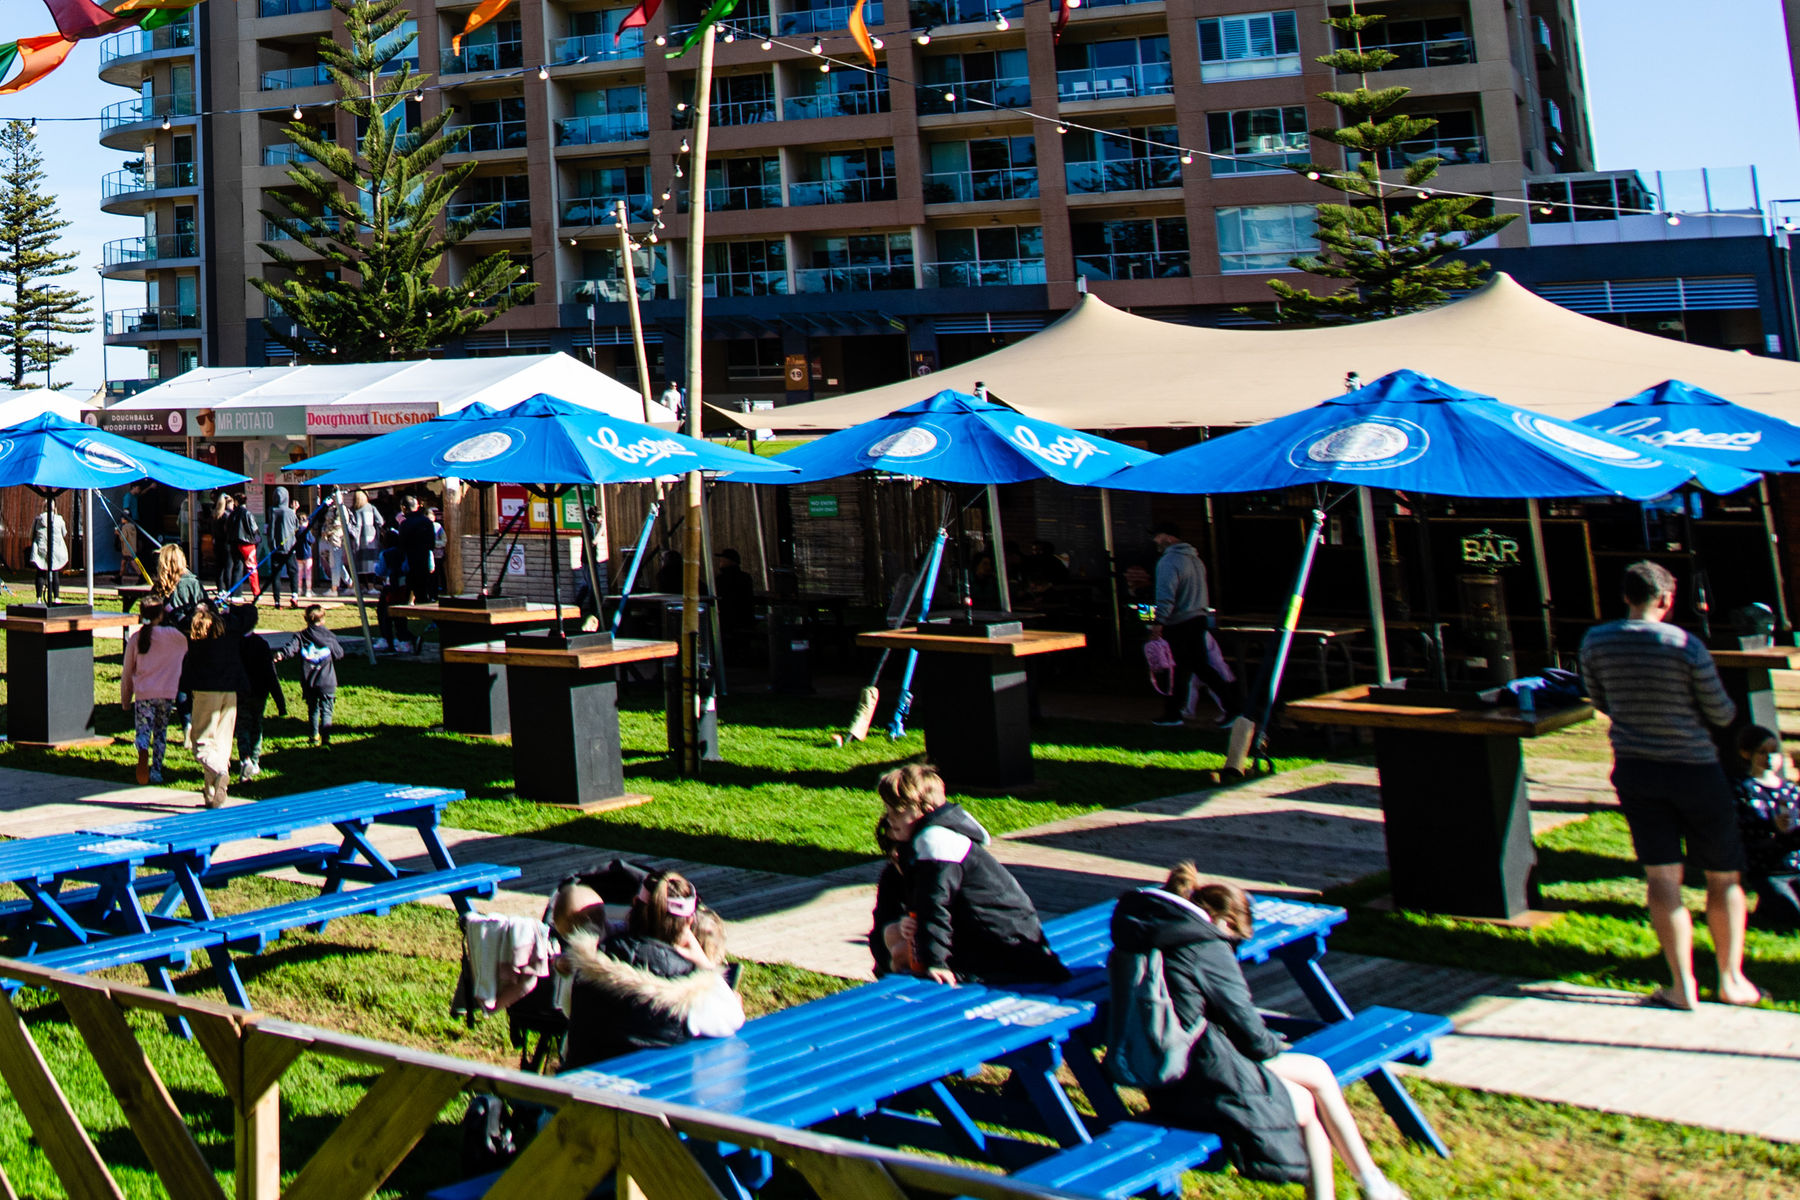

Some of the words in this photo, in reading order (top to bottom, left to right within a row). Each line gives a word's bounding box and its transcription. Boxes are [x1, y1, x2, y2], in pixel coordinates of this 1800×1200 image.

[111, 414, 154, 422] DOUGHBALLS
[217, 412, 233, 430] MR
[235, 411, 275, 430] POTATO
[307, 412, 369, 429] Doughnut
[103, 424, 142, 432] WOODFIRED
[1461, 538, 1521, 563] BAR
